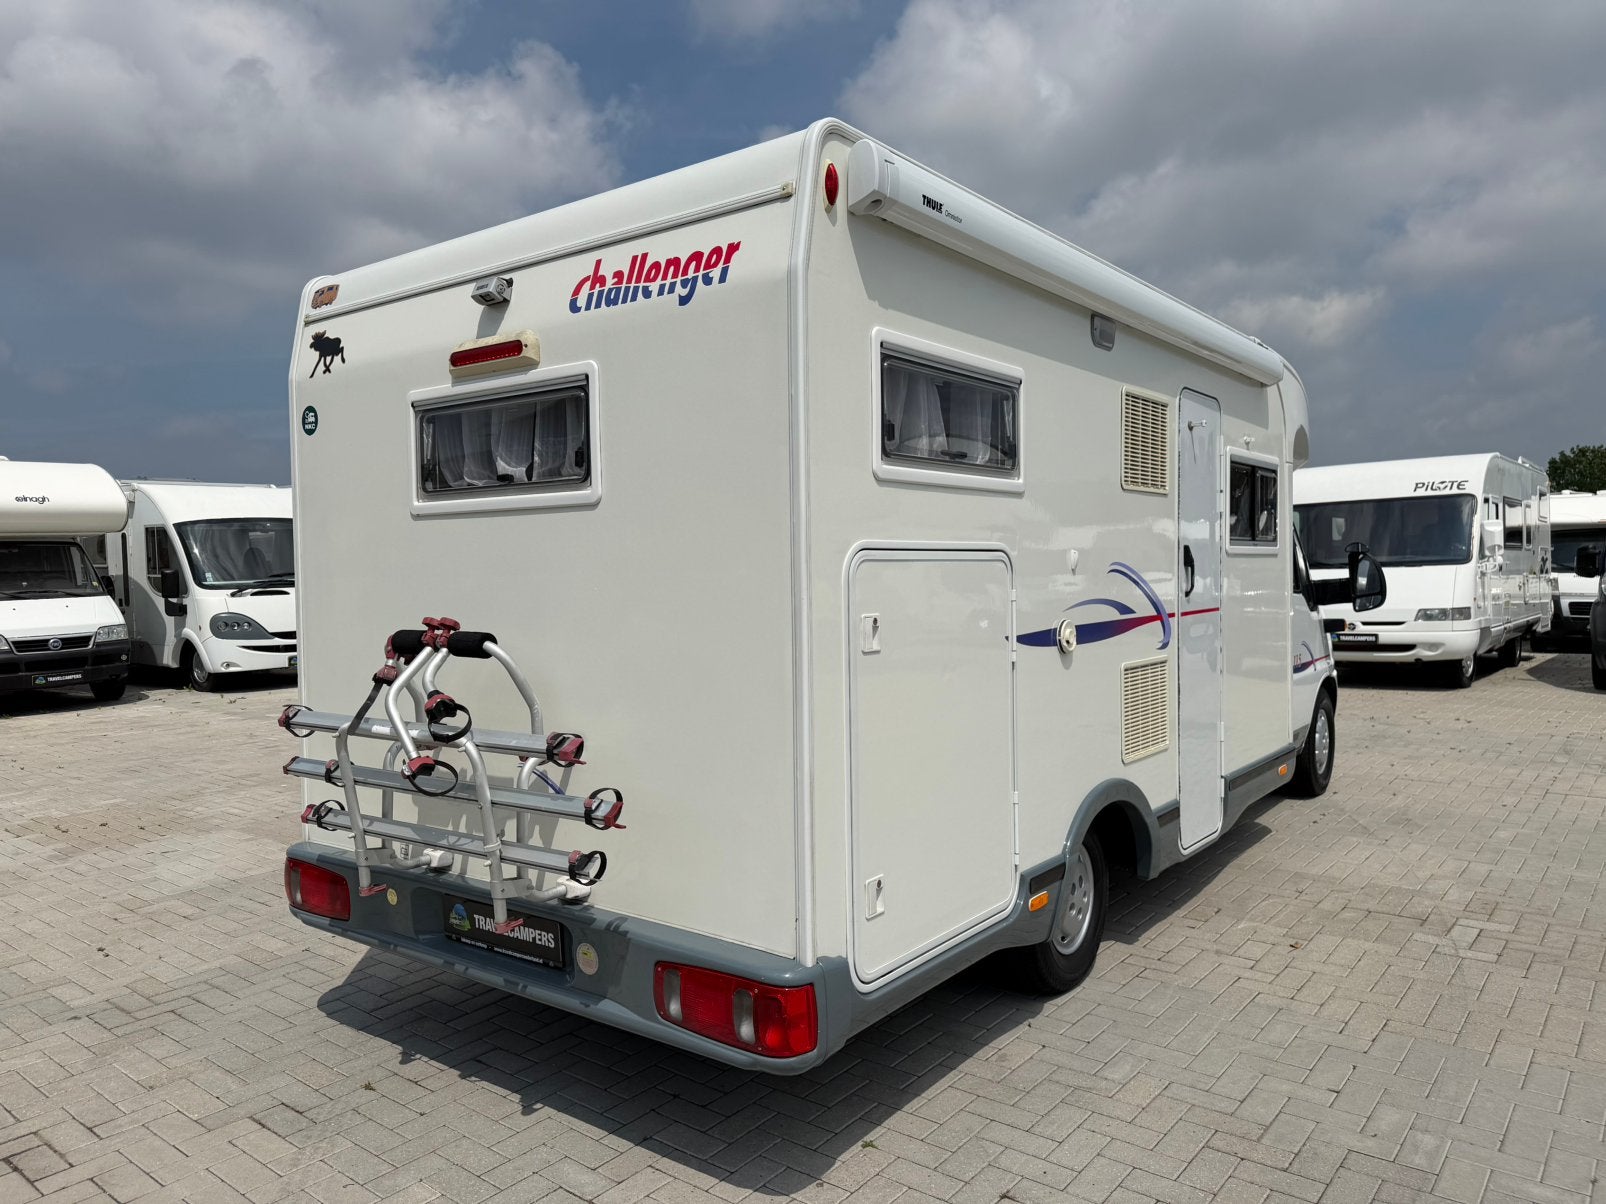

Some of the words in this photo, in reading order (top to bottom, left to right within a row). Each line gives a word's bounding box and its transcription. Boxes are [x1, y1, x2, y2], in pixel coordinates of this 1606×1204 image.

[922, 194, 943, 214] THULE
[568, 240, 742, 314] challenger
[47, 673, 82, 682] TRAVELCAMPERS
[473, 913, 555, 949] TRAVCAMPERS
